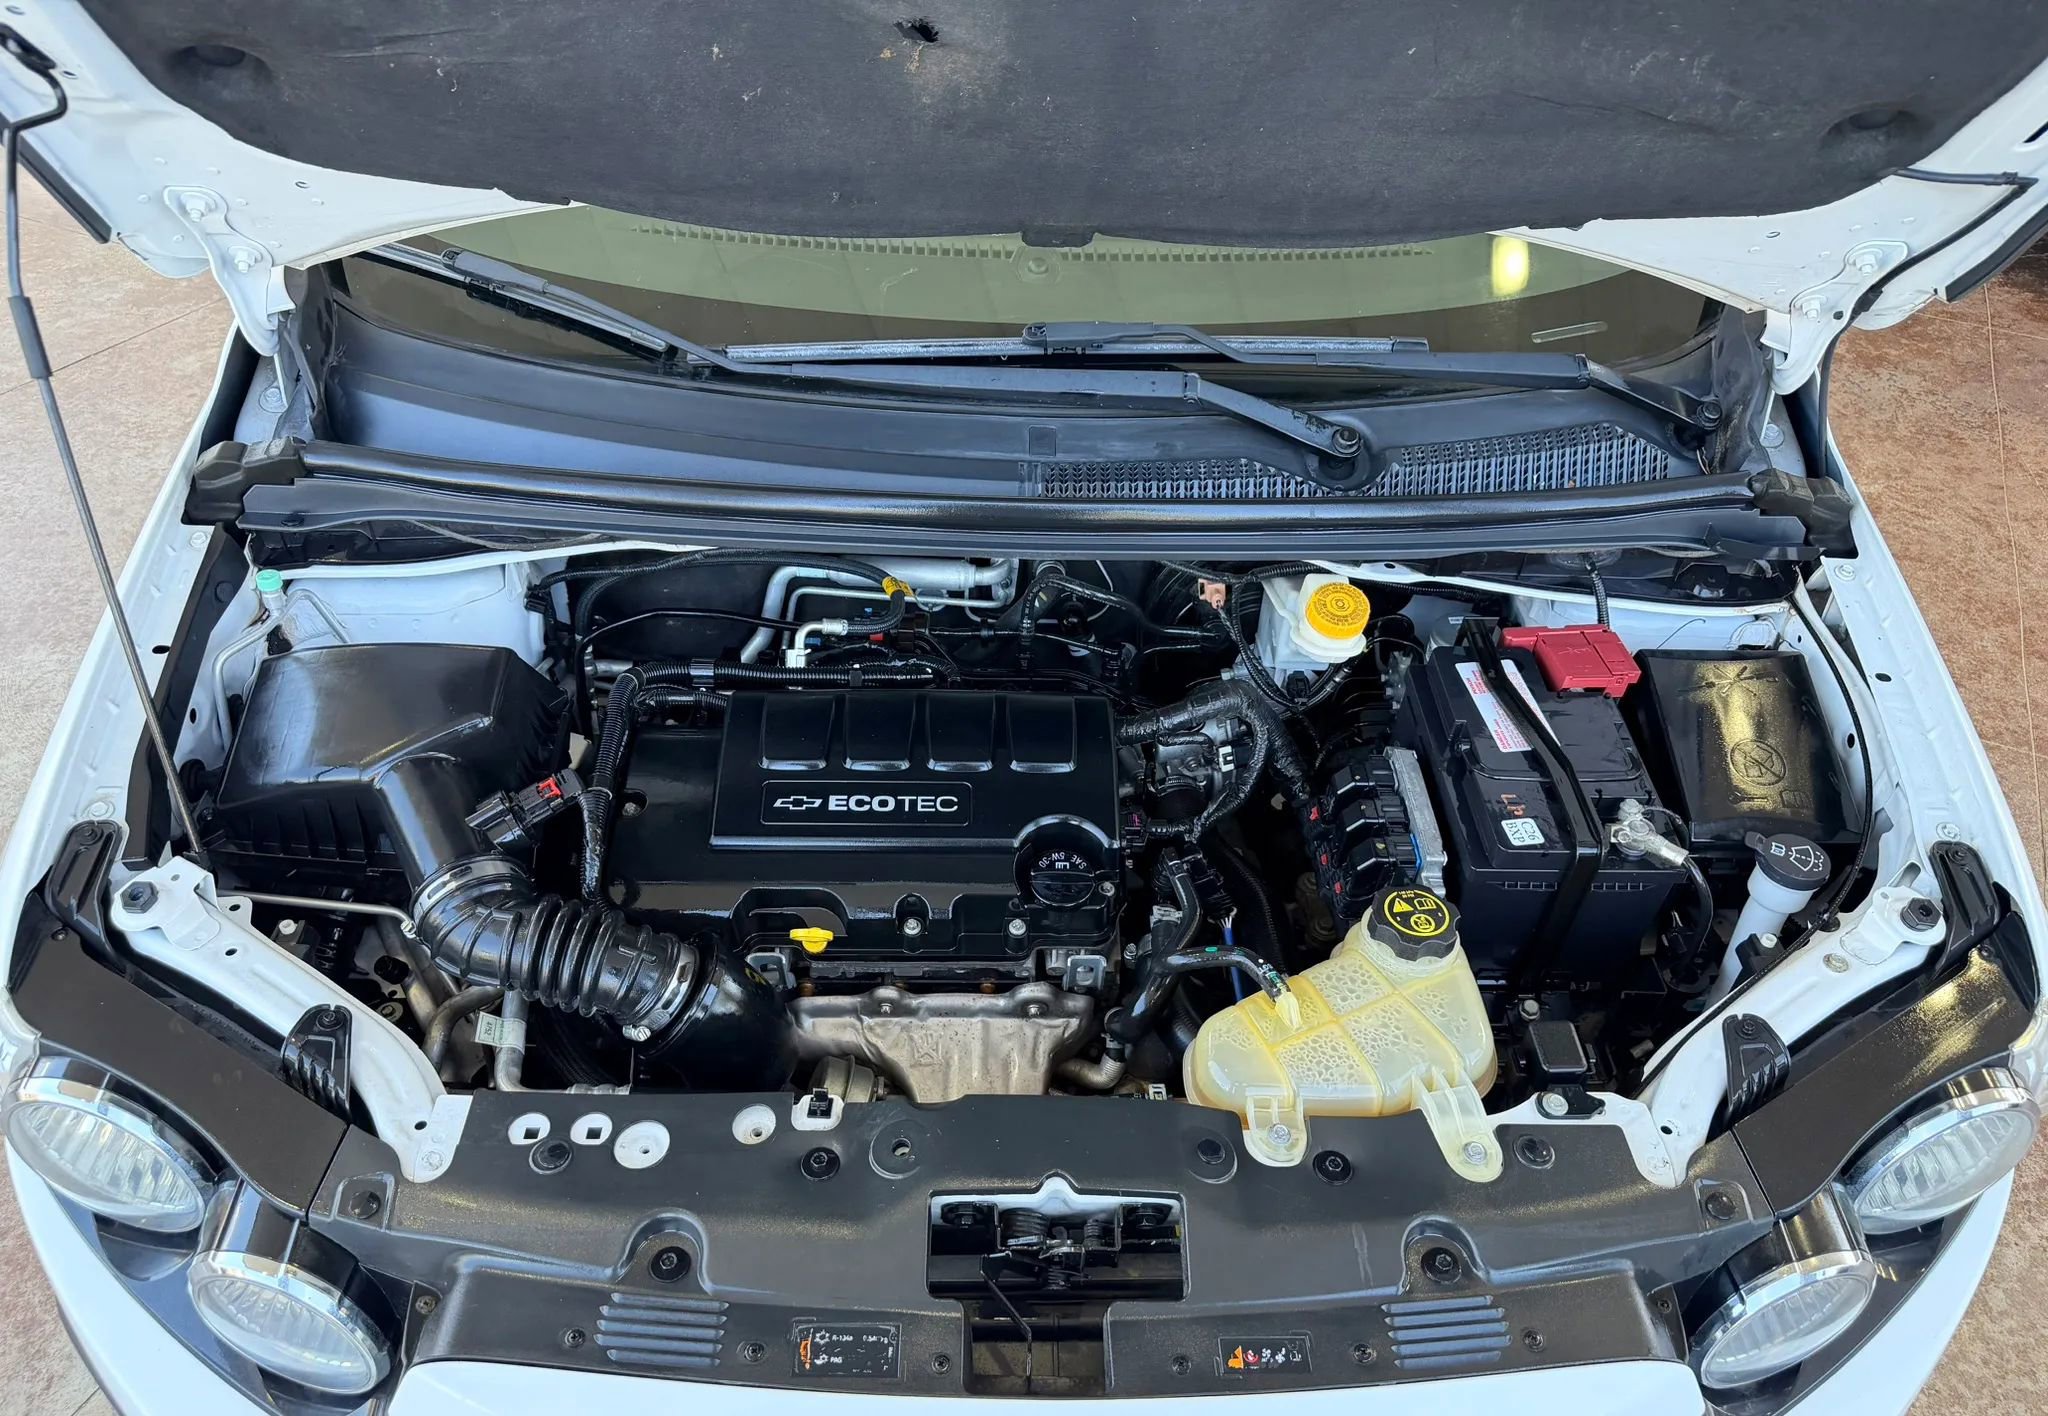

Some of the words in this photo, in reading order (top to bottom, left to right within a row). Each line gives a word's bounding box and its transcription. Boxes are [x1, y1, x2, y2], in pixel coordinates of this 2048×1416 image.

[828, 795, 959, 812] ECOTEC
[1505, 822, 1526, 843] BXP
[1521, 821, 1540, 841] C26
[1038, 851, 1066, 868] 5W-30
[1070, 854, 1087, 870] SAE
